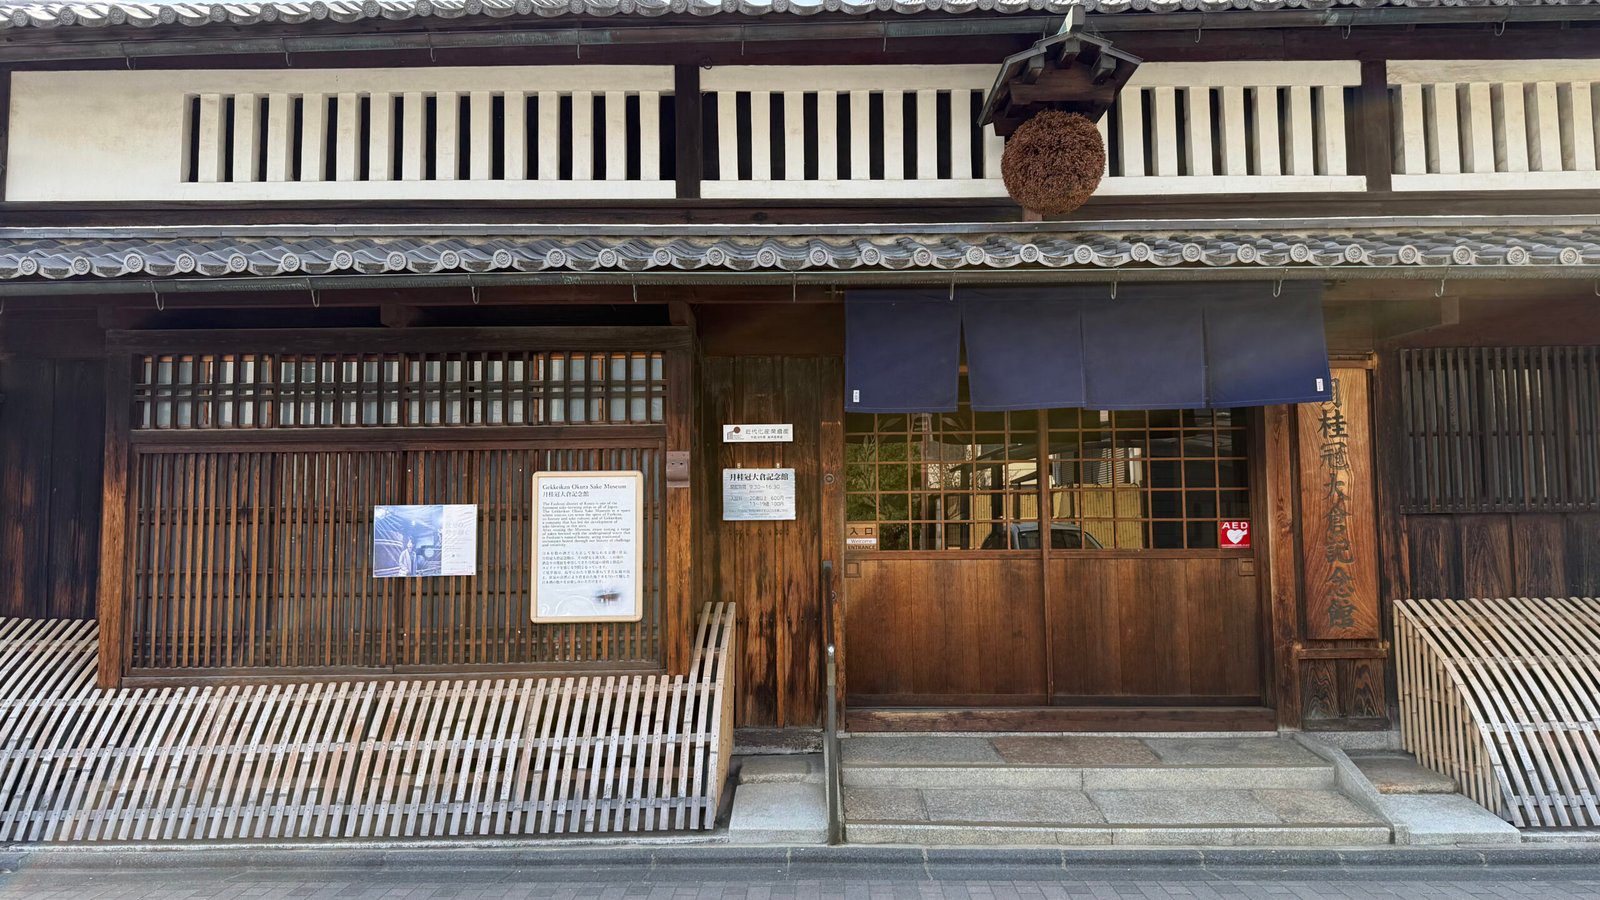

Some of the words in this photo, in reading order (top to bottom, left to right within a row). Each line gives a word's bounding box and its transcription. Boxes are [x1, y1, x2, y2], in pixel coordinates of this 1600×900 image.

[729, 473, 789, 481] 月桂冠大倉記念館
[1221, 521, 1249, 530] AED
[849, 527, 873, 536] 入口
